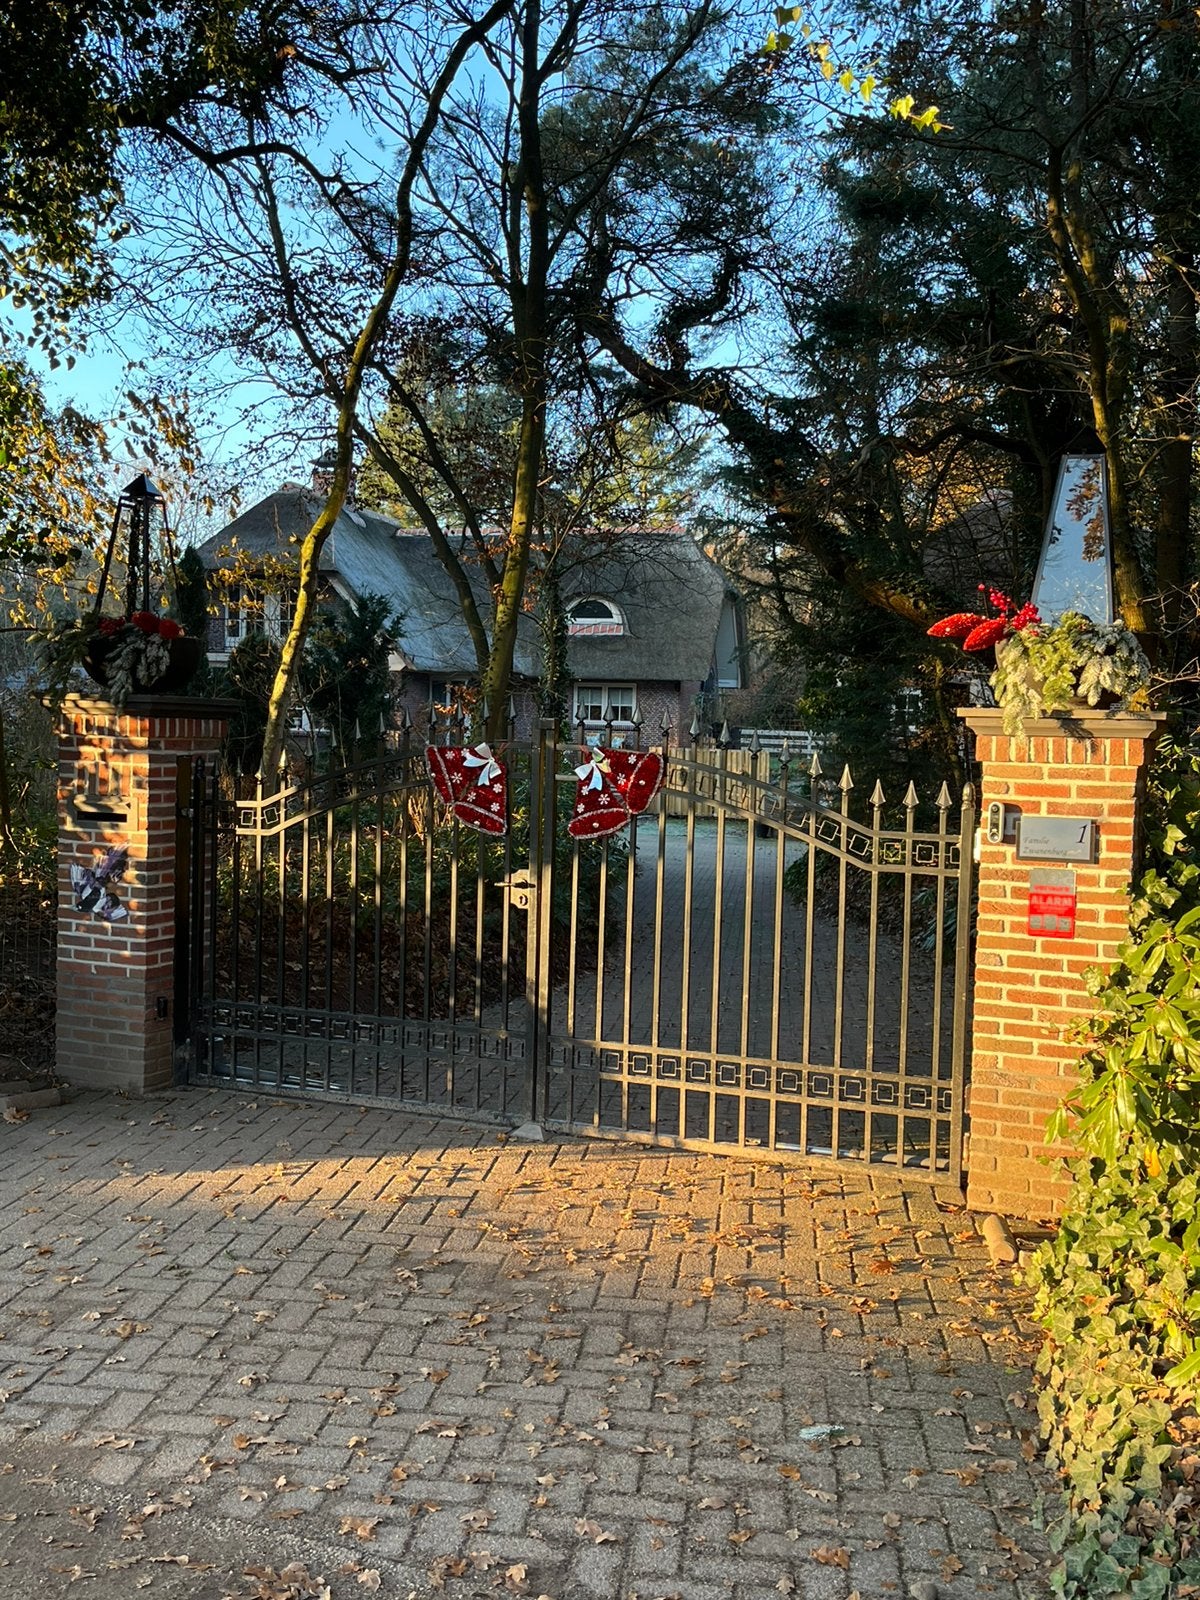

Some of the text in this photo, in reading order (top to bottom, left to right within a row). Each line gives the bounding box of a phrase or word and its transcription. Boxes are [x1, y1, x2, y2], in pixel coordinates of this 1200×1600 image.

[1077, 824, 1088, 844] 1
[1023, 836, 1050, 844] Familie
[1031, 895, 1072, 906] ALARM
